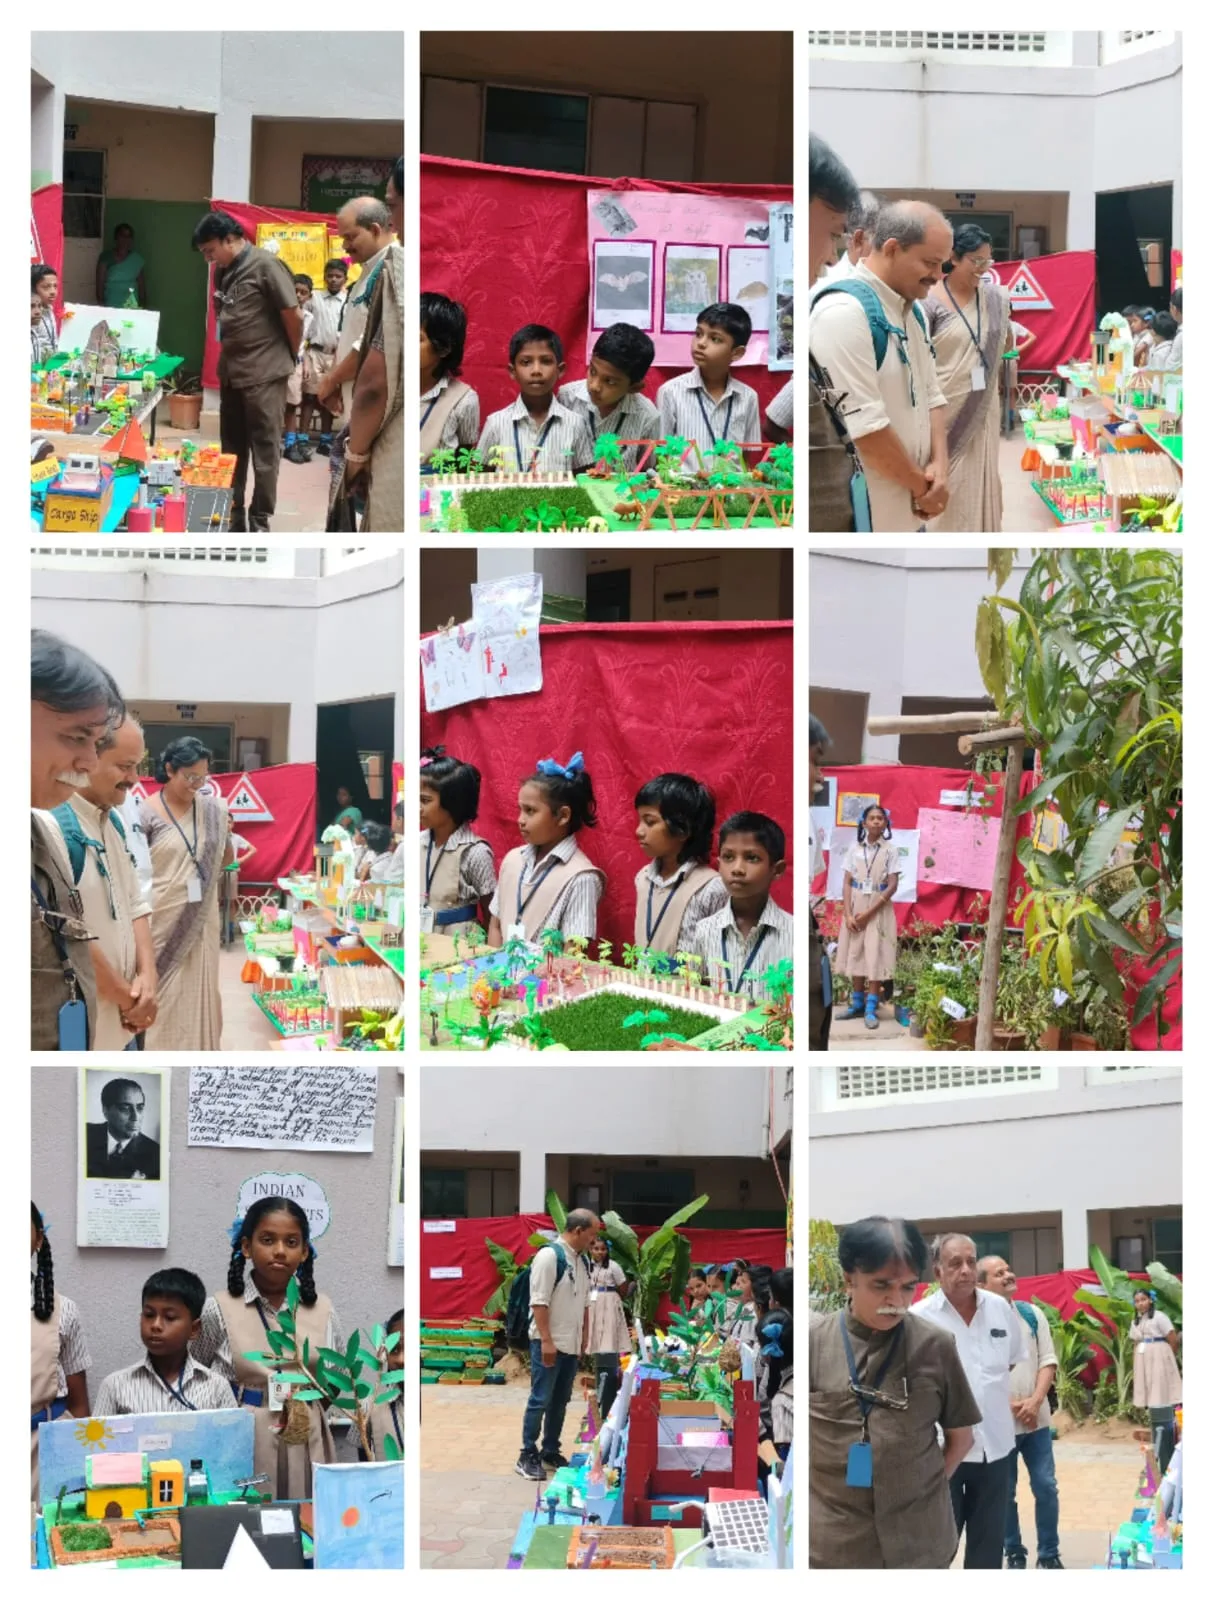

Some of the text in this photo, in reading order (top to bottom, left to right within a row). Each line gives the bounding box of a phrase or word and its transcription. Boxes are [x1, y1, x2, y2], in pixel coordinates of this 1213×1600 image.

[50, 507, 99, 528] Cargo Ship
[253, 1182, 305, 1198] INDIAN
